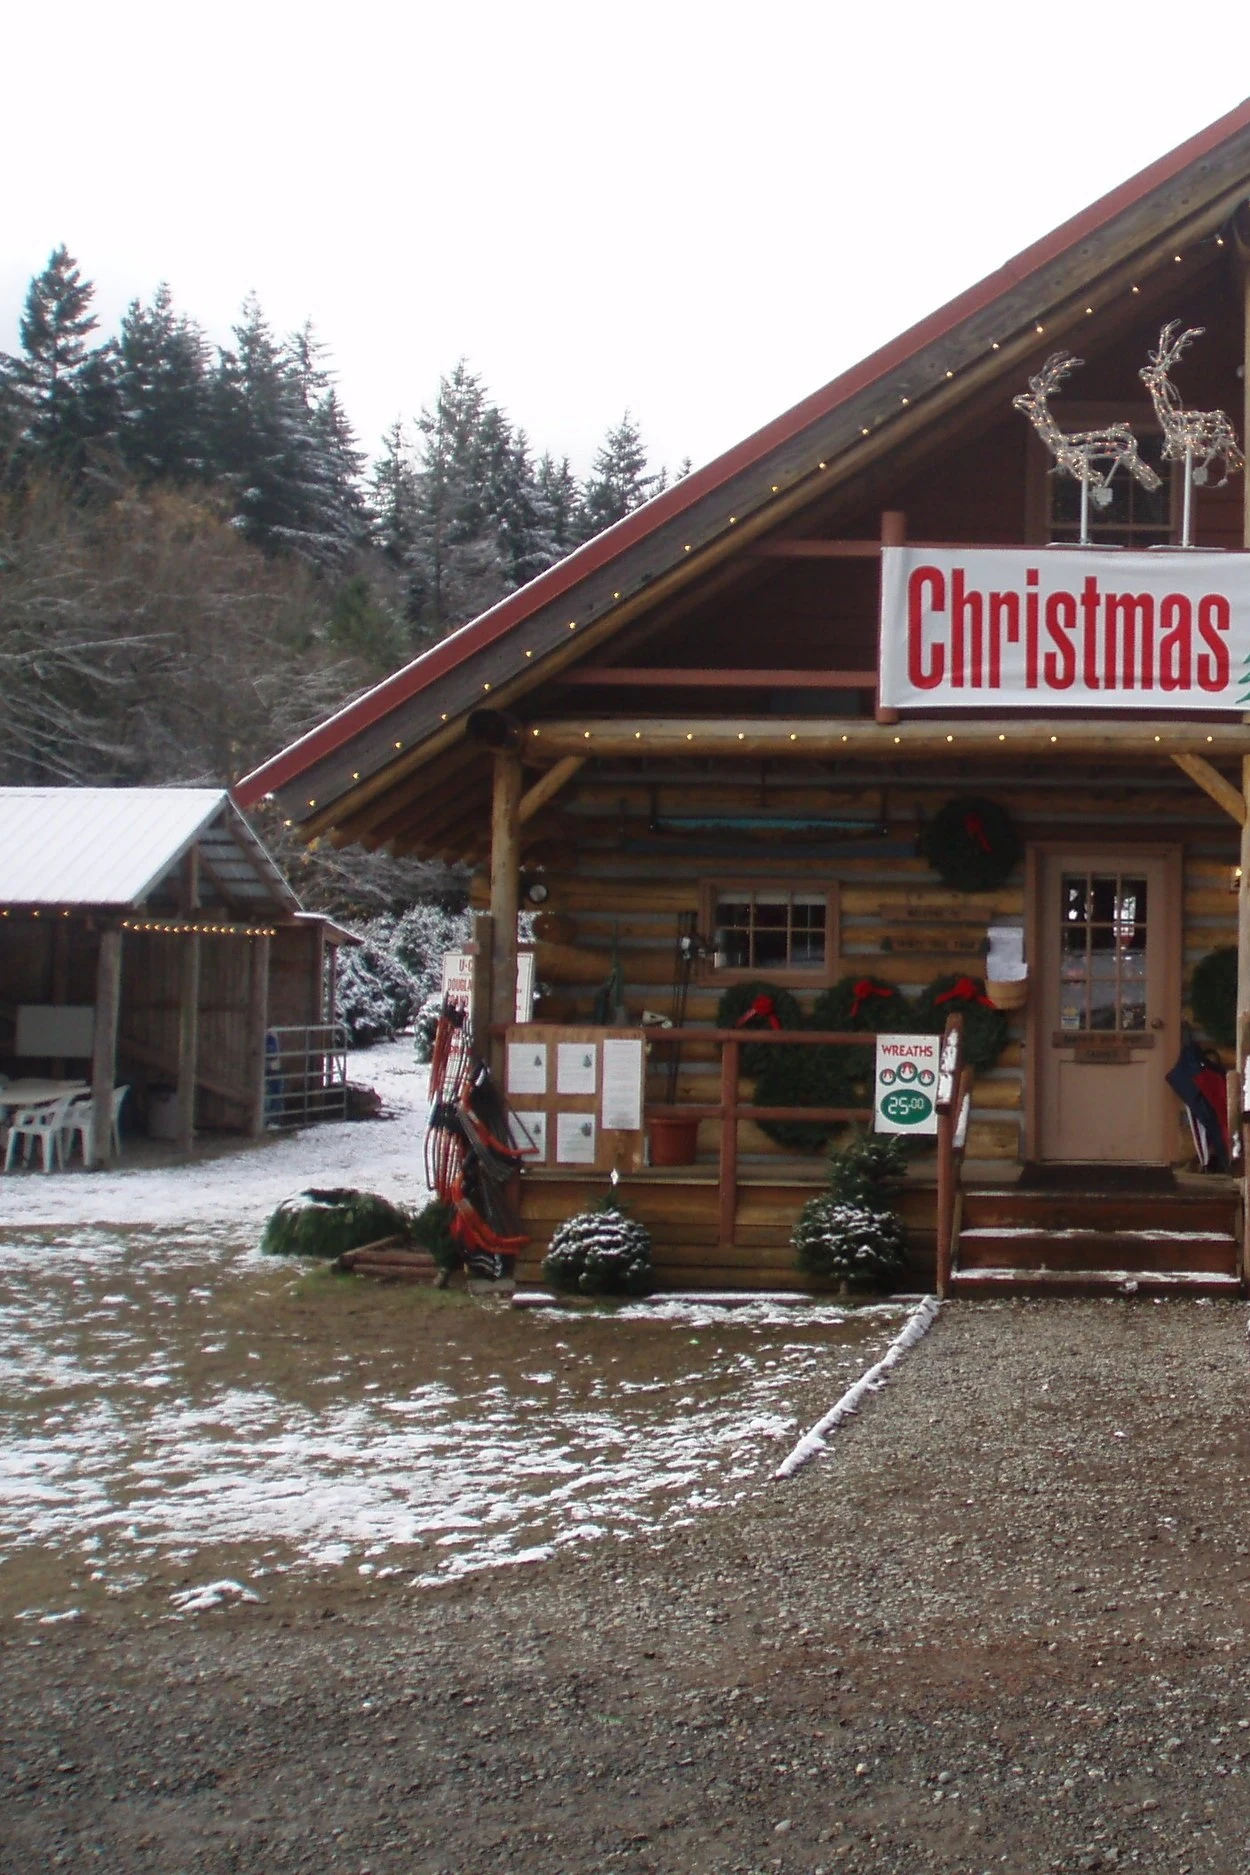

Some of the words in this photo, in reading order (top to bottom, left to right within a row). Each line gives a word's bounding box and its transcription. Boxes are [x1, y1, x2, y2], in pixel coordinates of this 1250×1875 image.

[907, 564, 1230, 692] Christmas
[881, 1044, 933, 1058] WREATHS
[887, 1096, 925, 1115] 25.00
